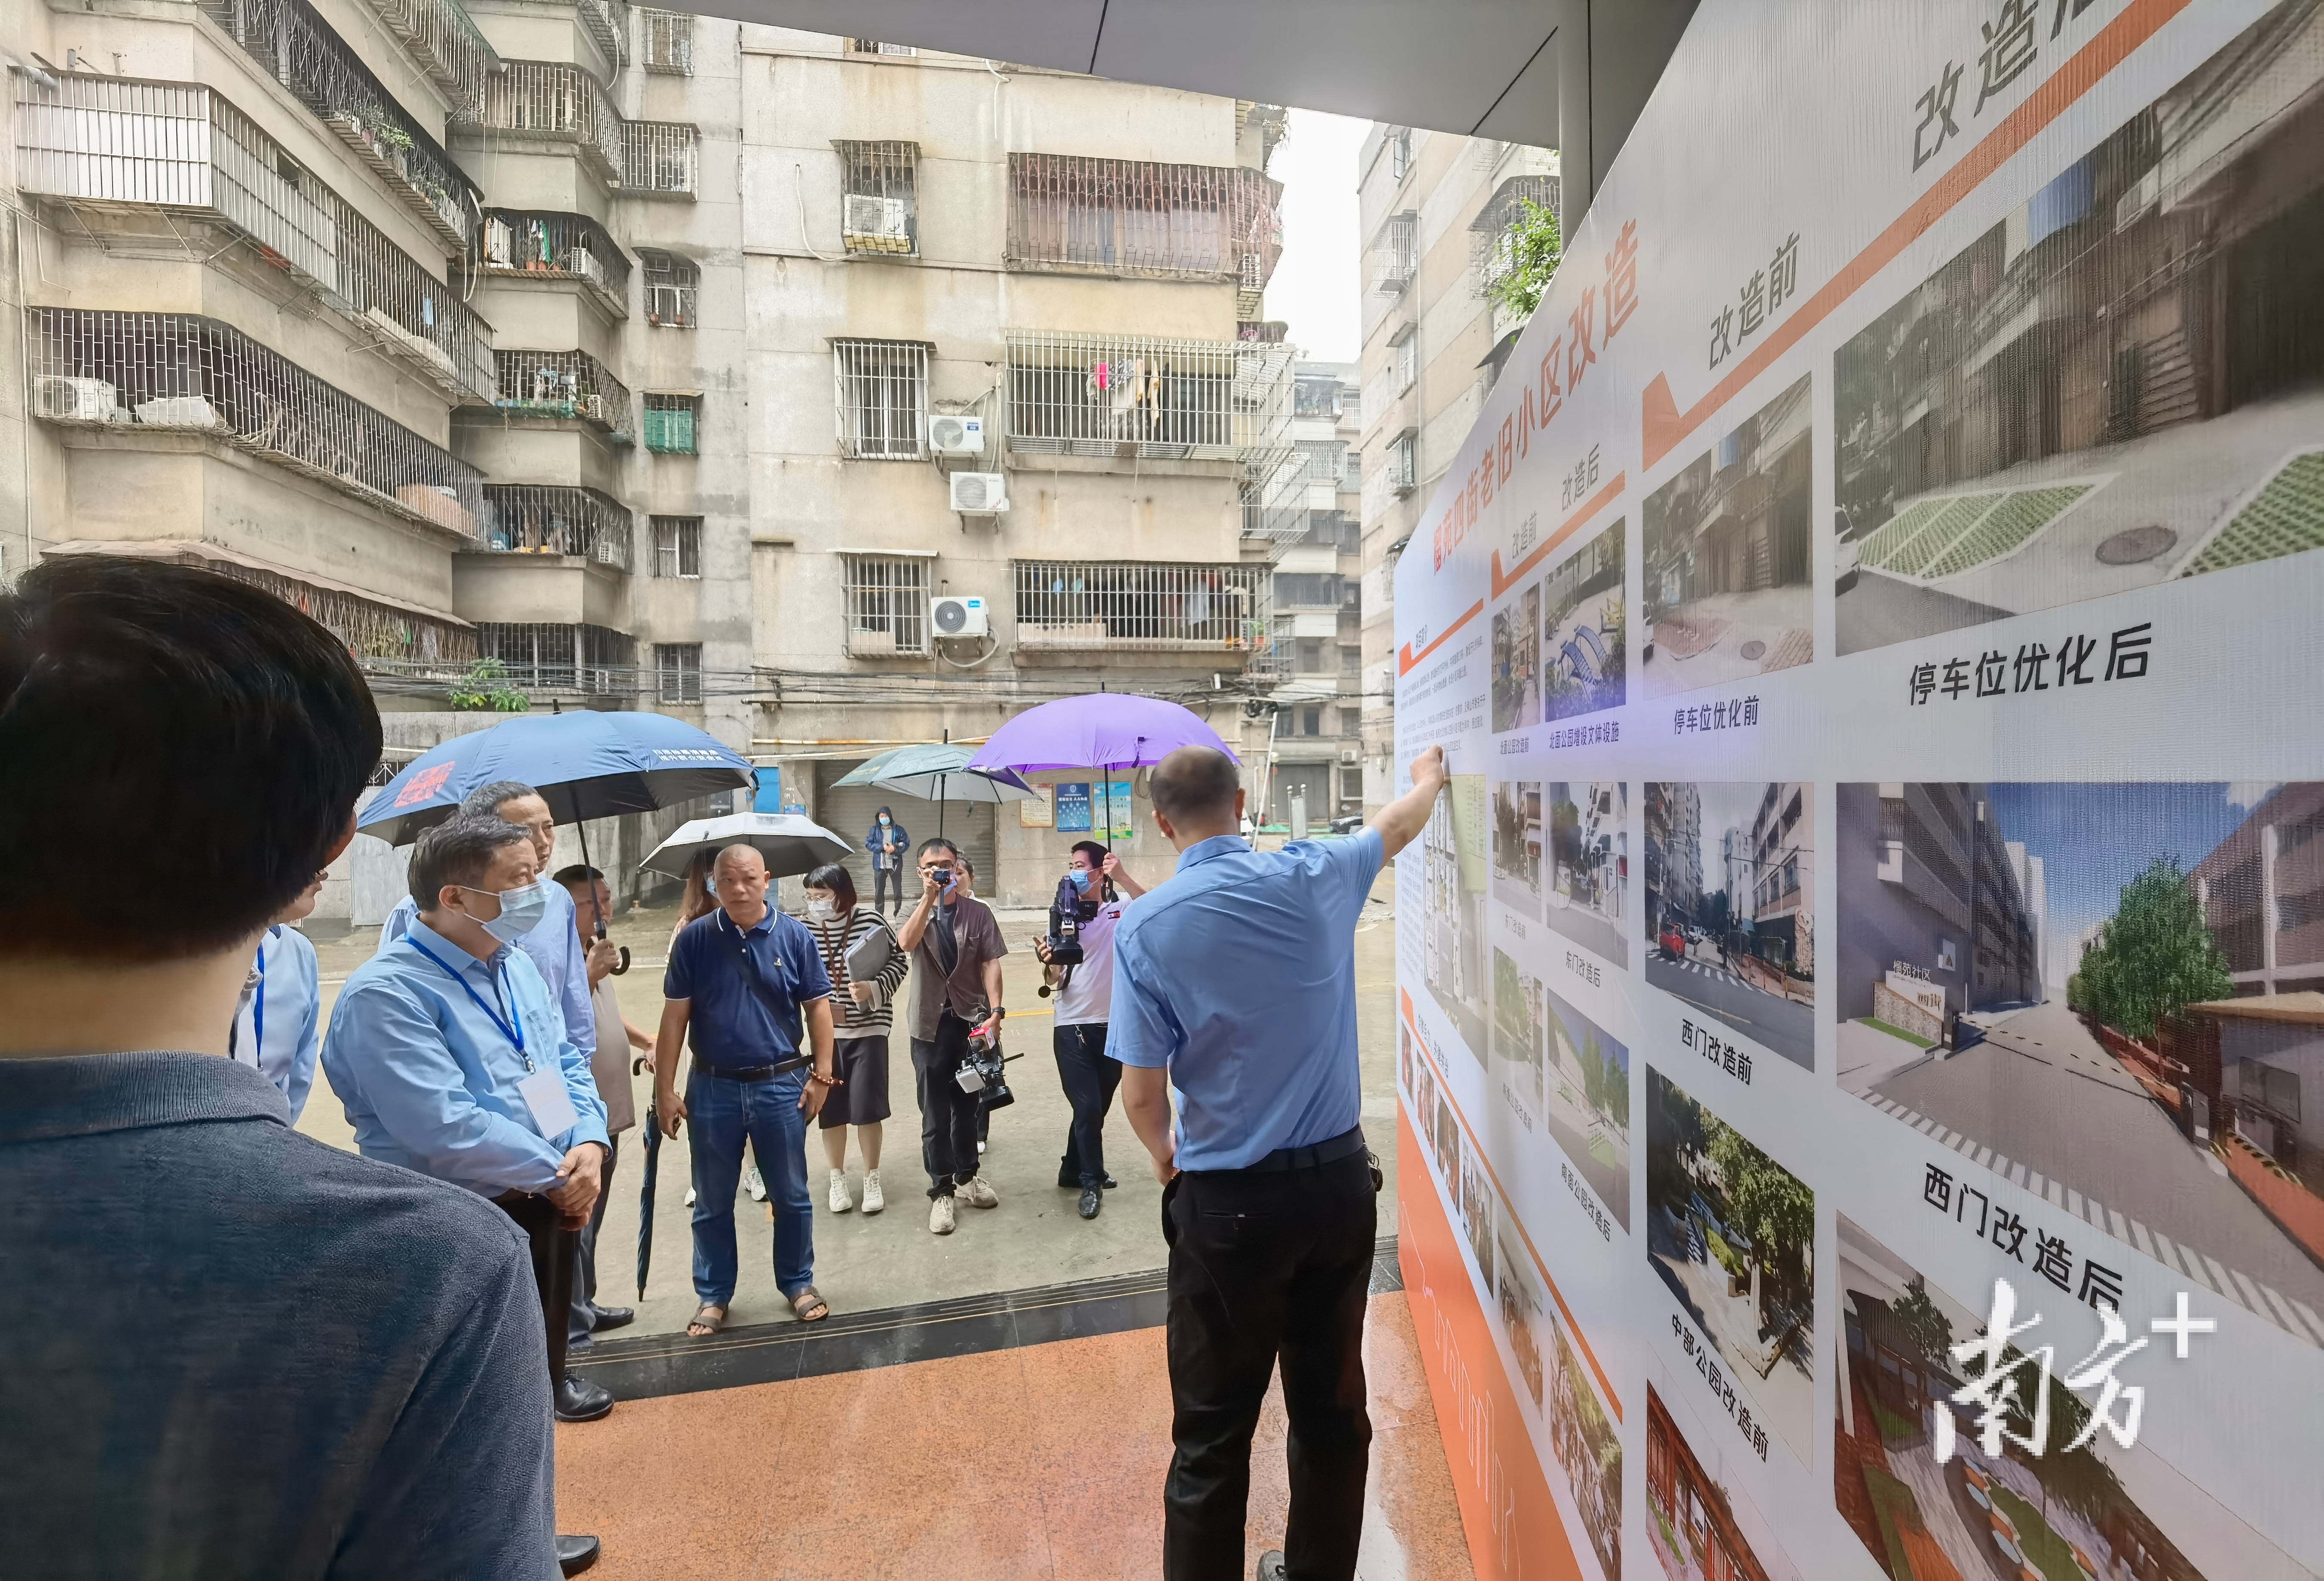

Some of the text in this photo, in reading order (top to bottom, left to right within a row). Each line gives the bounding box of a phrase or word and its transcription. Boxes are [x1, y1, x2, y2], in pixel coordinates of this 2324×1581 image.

[1709, 231, 1799, 370] 改造前
[1562, 443, 1599, 512] 改造后
[1512, 510, 1537, 559] 改造前
[1910, 622, 2152, 706] 停车位优化后
[1549, 720, 1619, 749] 北面公园增设文体设施
[1674, 695, 1759, 735] 停车位优化前
[1566, 950, 1601, 988] 东门改造后
[1682, 1018, 1752, 1086] 西门改造前
[1562, 1162, 1611, 1242] 南面公园改造后
[1925, 1163, 2123, 1313] 西门改造后
[1672, 1313, 1769, 1464] 中部公园改造前
